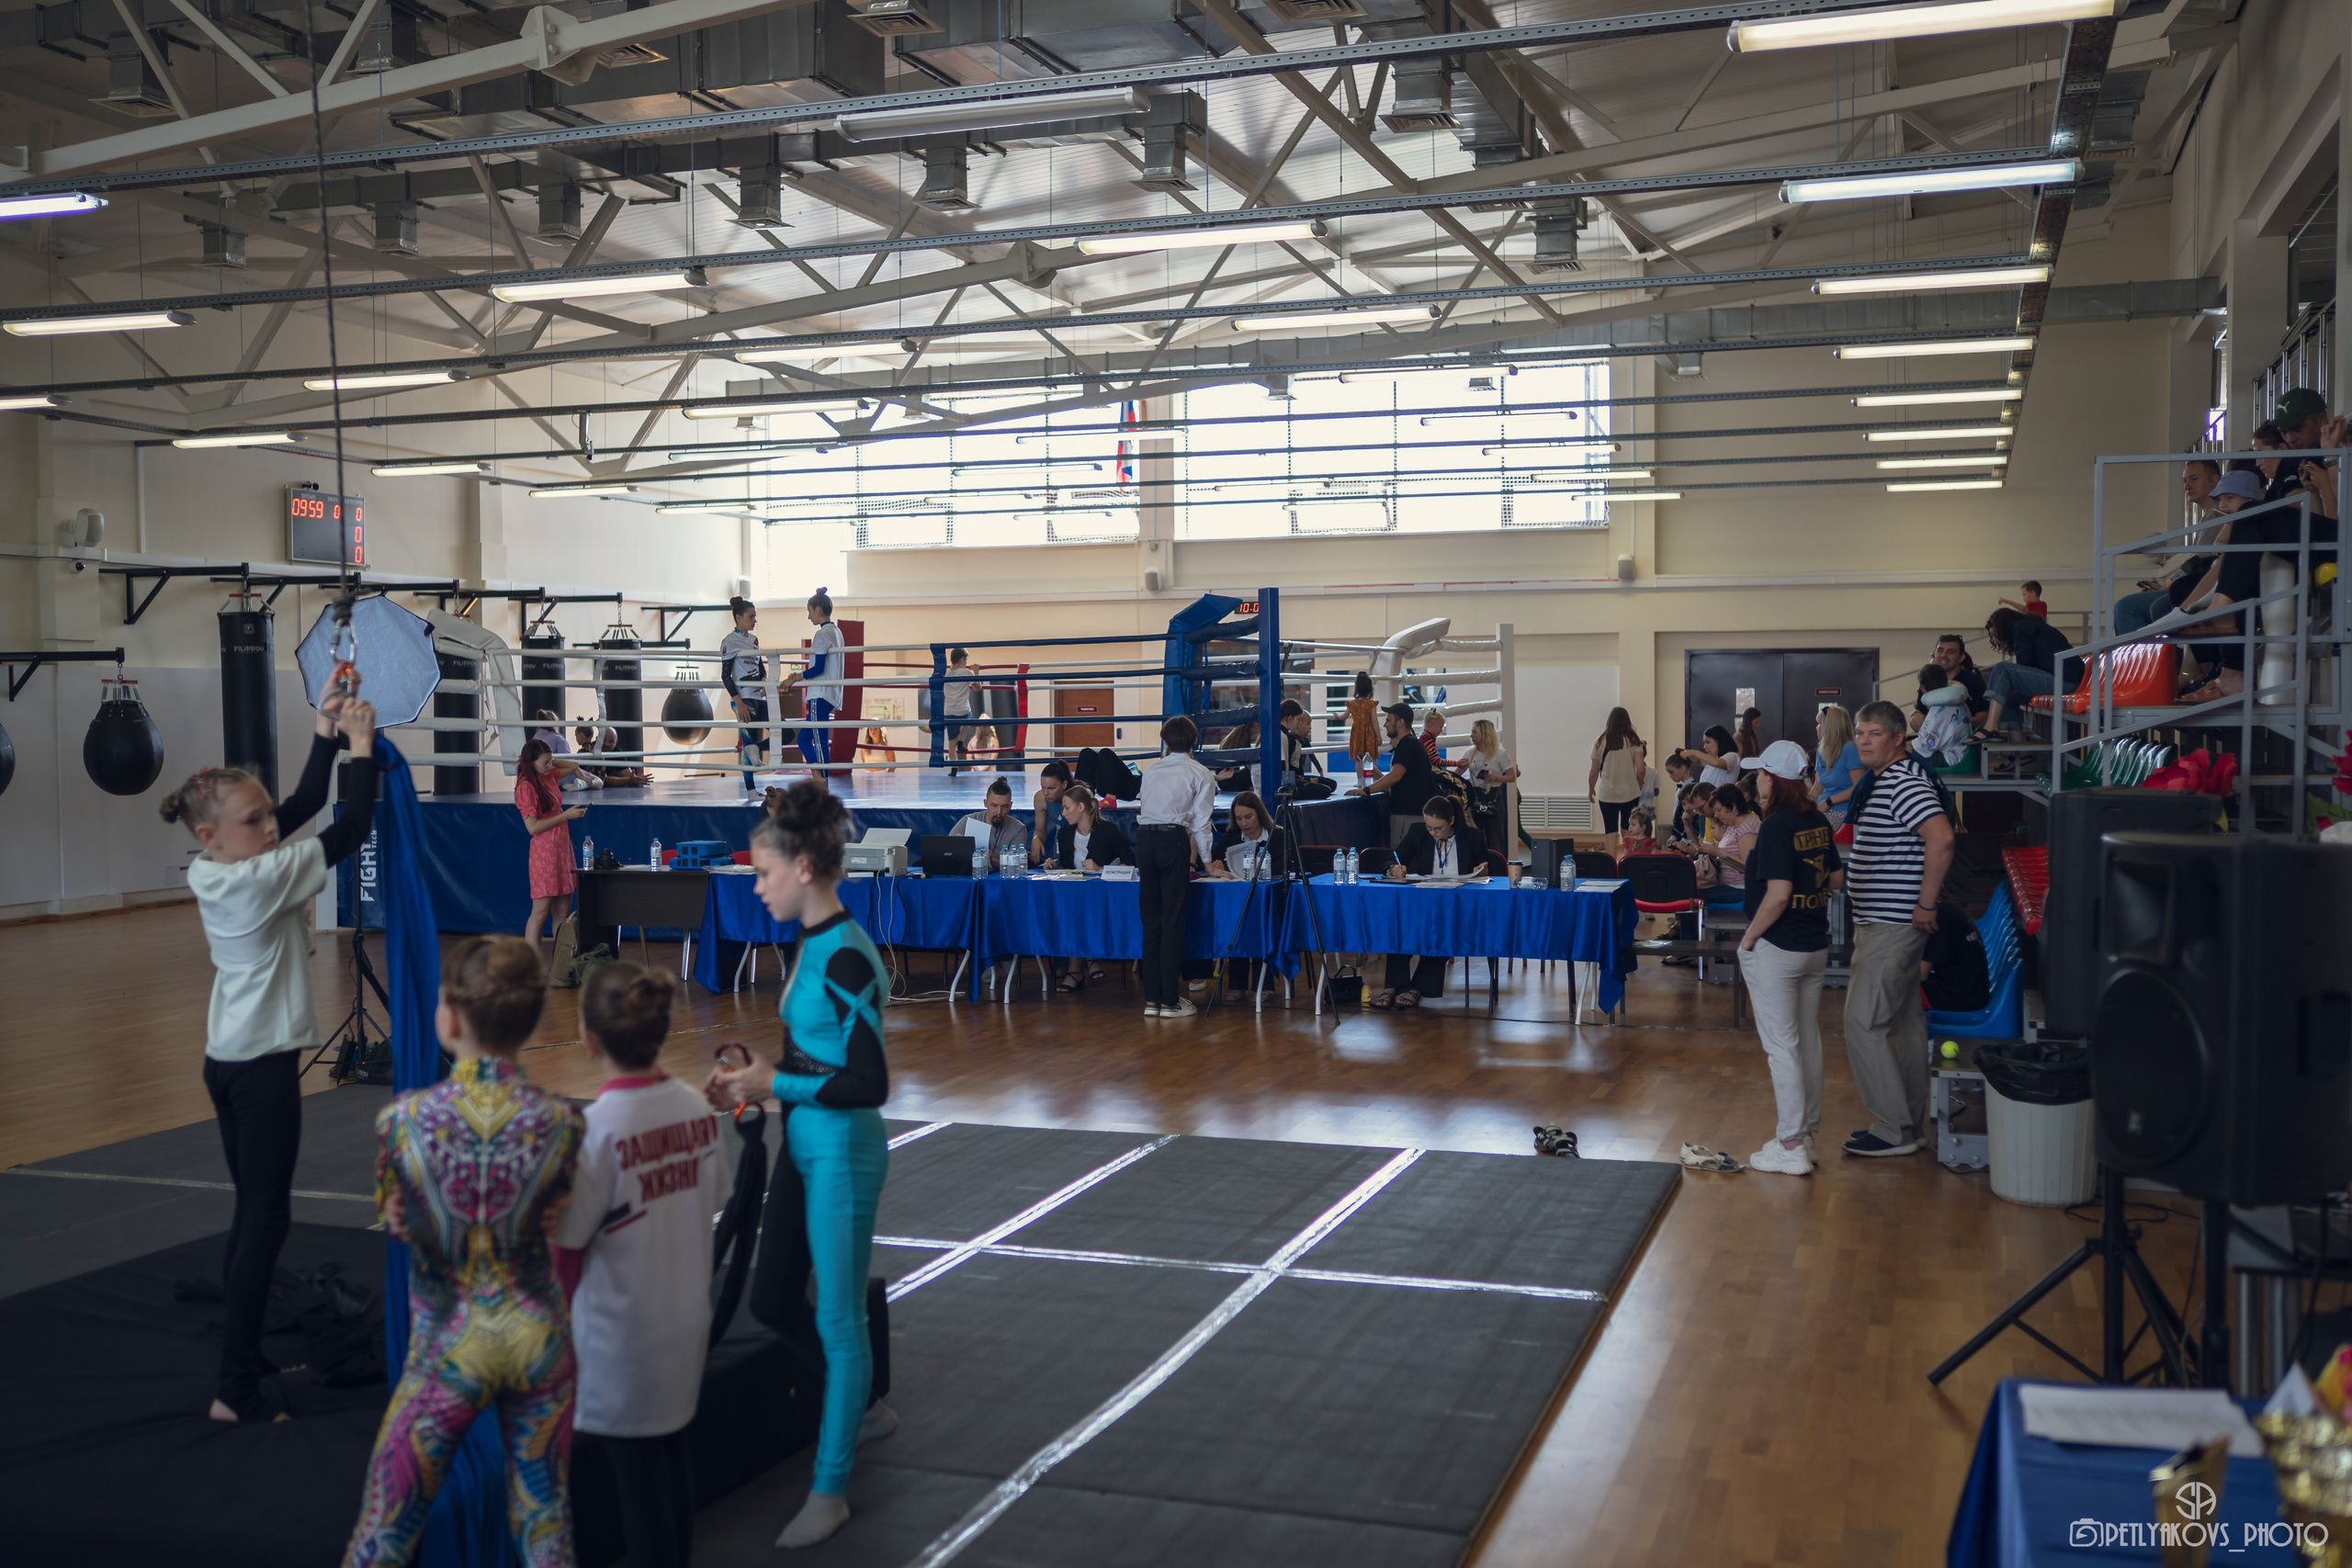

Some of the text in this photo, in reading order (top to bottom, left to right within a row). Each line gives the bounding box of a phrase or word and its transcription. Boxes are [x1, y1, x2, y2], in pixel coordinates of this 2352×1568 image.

[356, 507, 363, 522] 0
[355, 525, 363, 544] 0
[355, 546, 363, 563] 0
[360, 841, 377, 901] FIGHT
